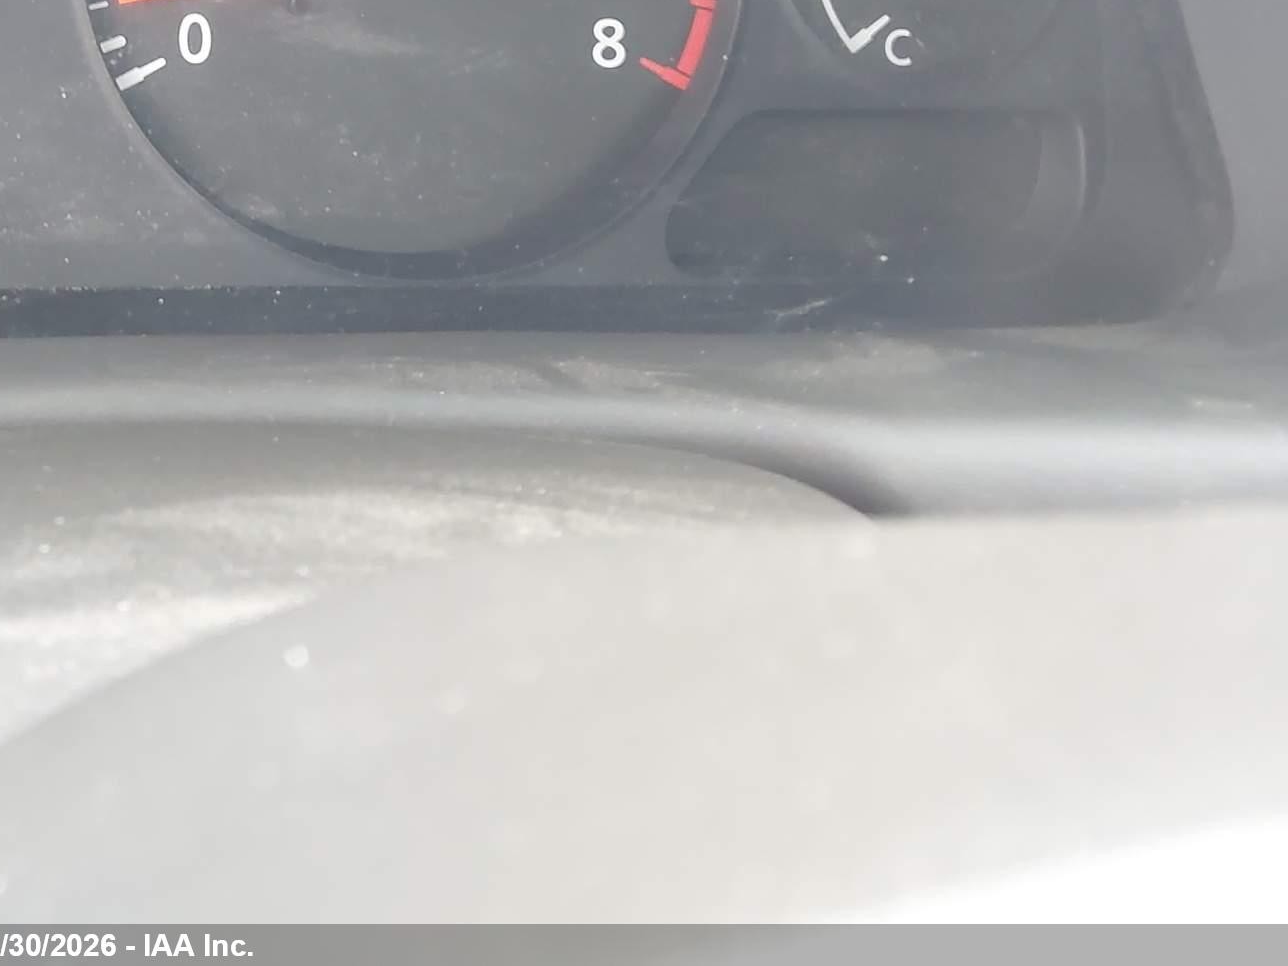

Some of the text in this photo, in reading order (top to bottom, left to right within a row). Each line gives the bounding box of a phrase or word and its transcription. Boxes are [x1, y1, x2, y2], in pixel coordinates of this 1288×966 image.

[179, 14, 211, 63] 0
[593, 19, 625, 68] 8
[885, 29, 911, 66] C
